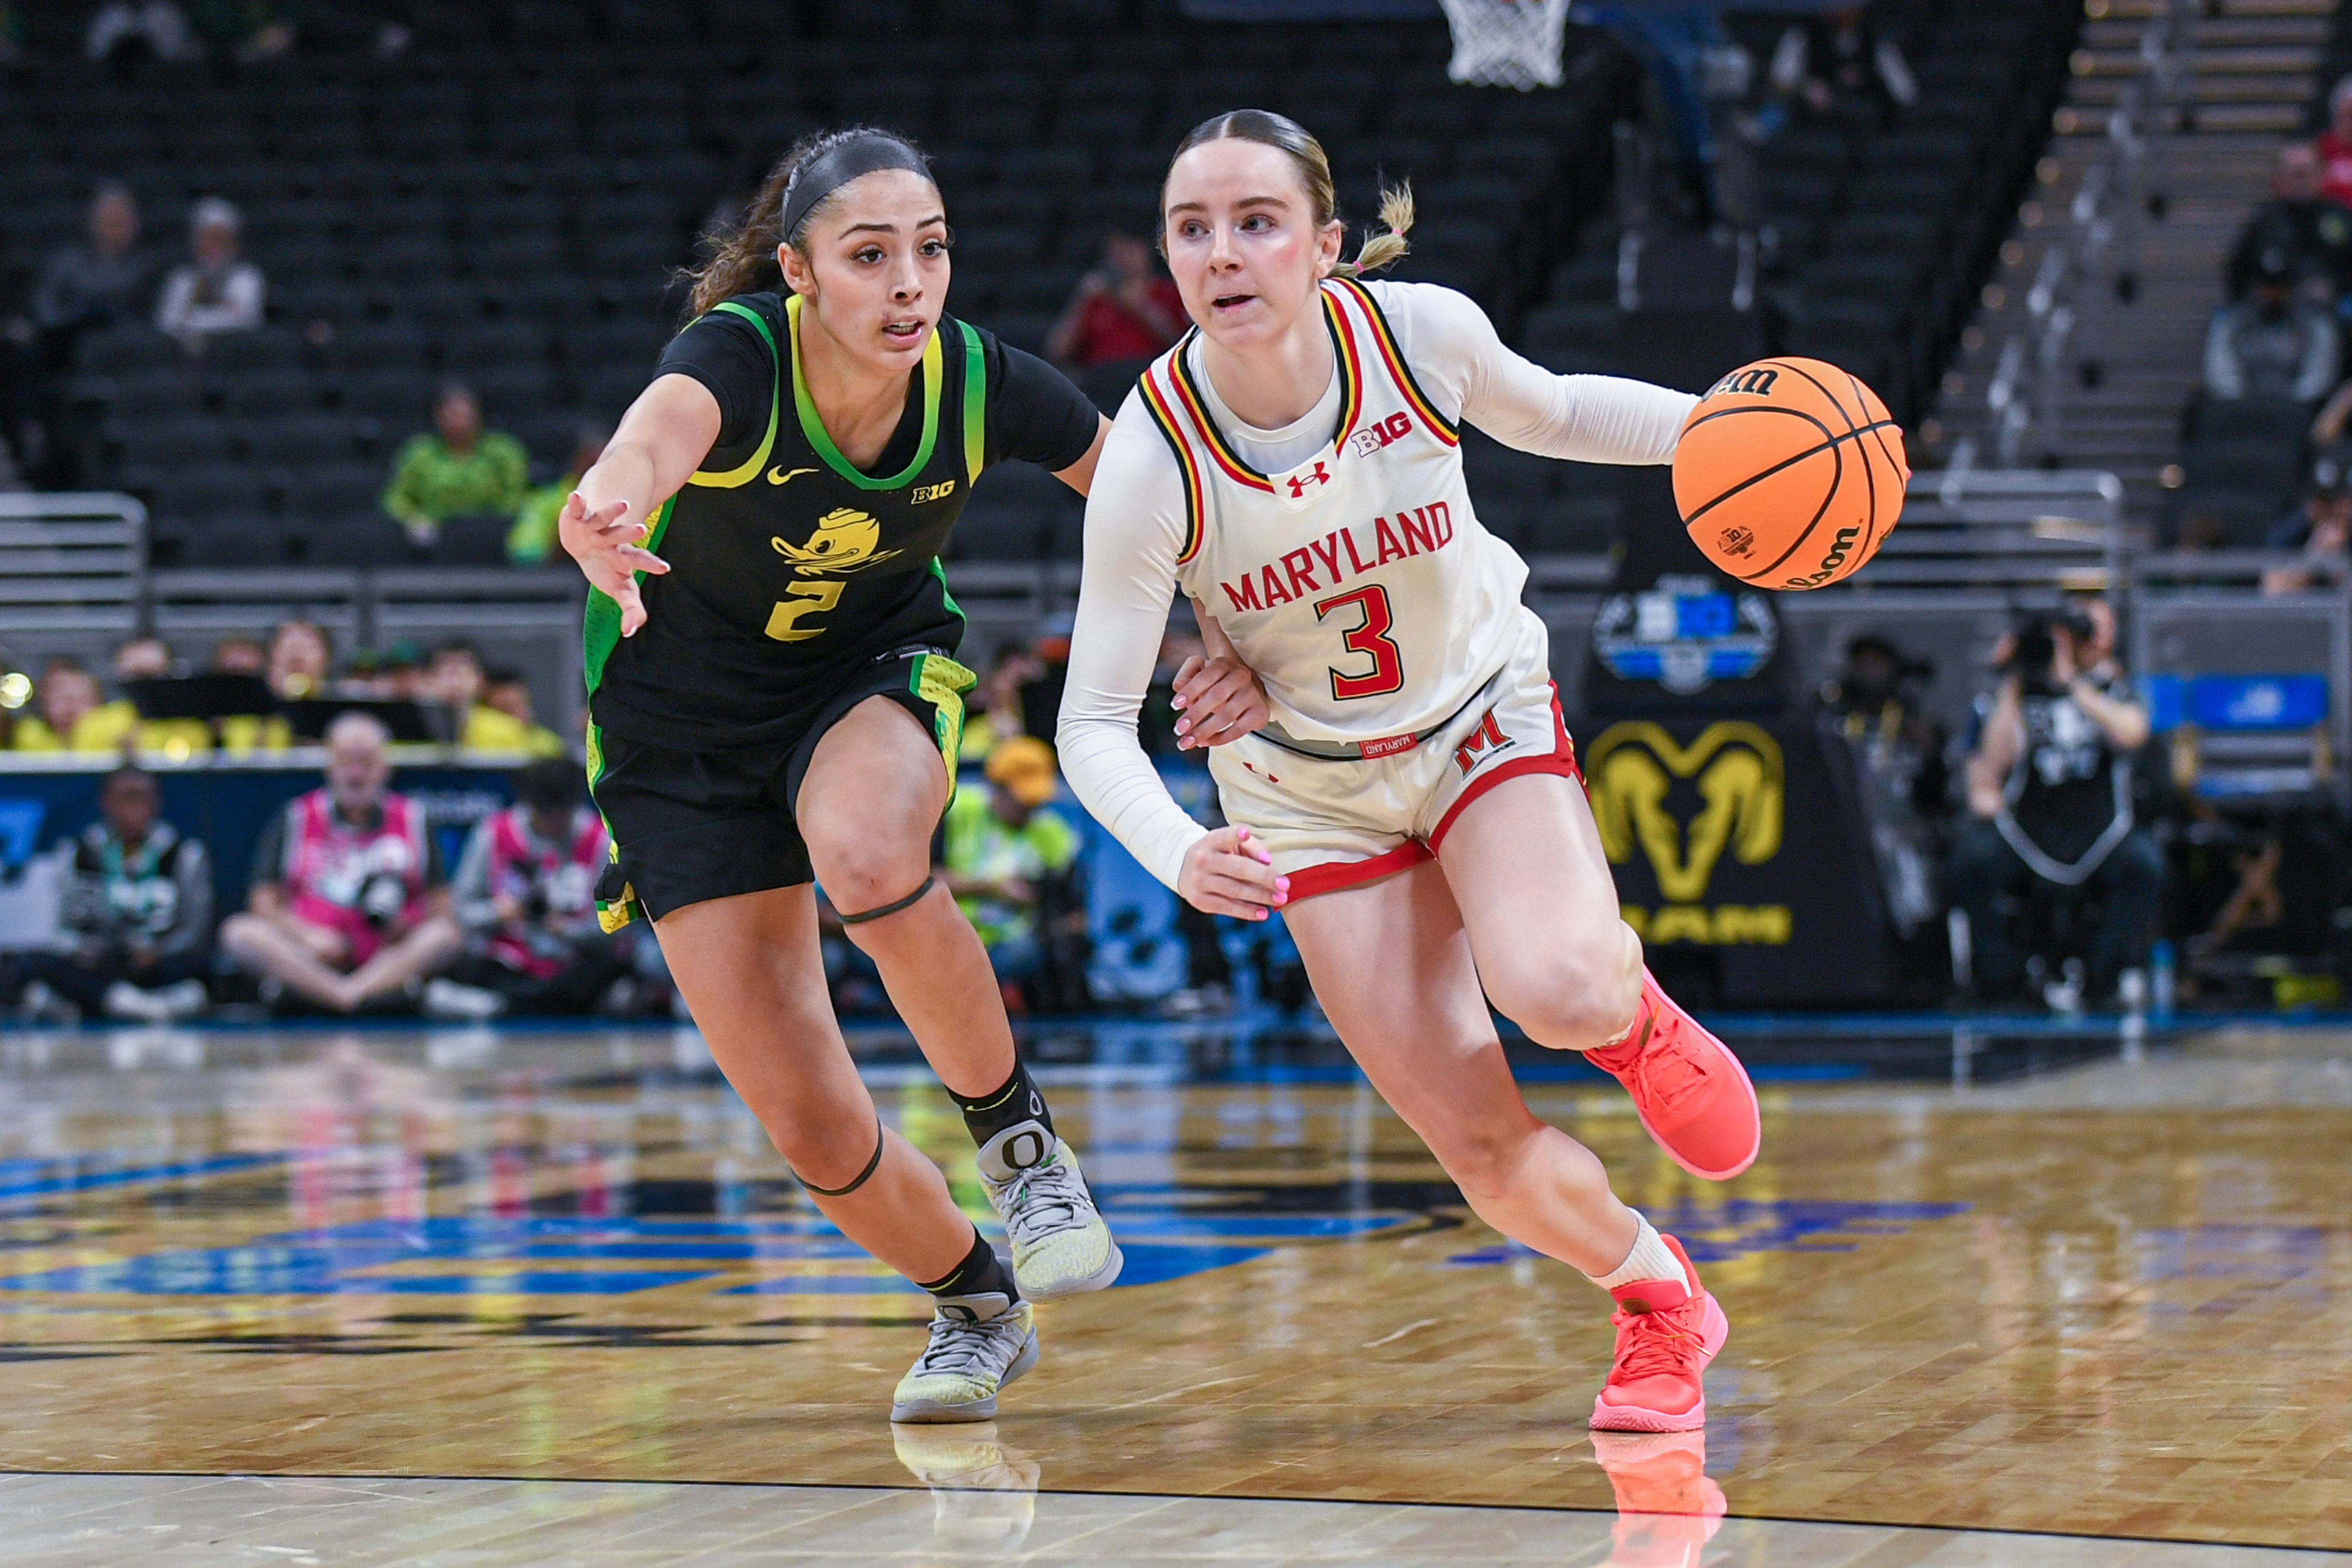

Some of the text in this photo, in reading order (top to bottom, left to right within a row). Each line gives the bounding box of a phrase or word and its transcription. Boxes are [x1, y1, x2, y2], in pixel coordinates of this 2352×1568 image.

[1220, 501, 1453, 613] MARYLAND
[765, 581, 847, 641] 2
[1314, 584, 1404, 701] 3
[1365, 734, 1411, 754] MARYLAND
